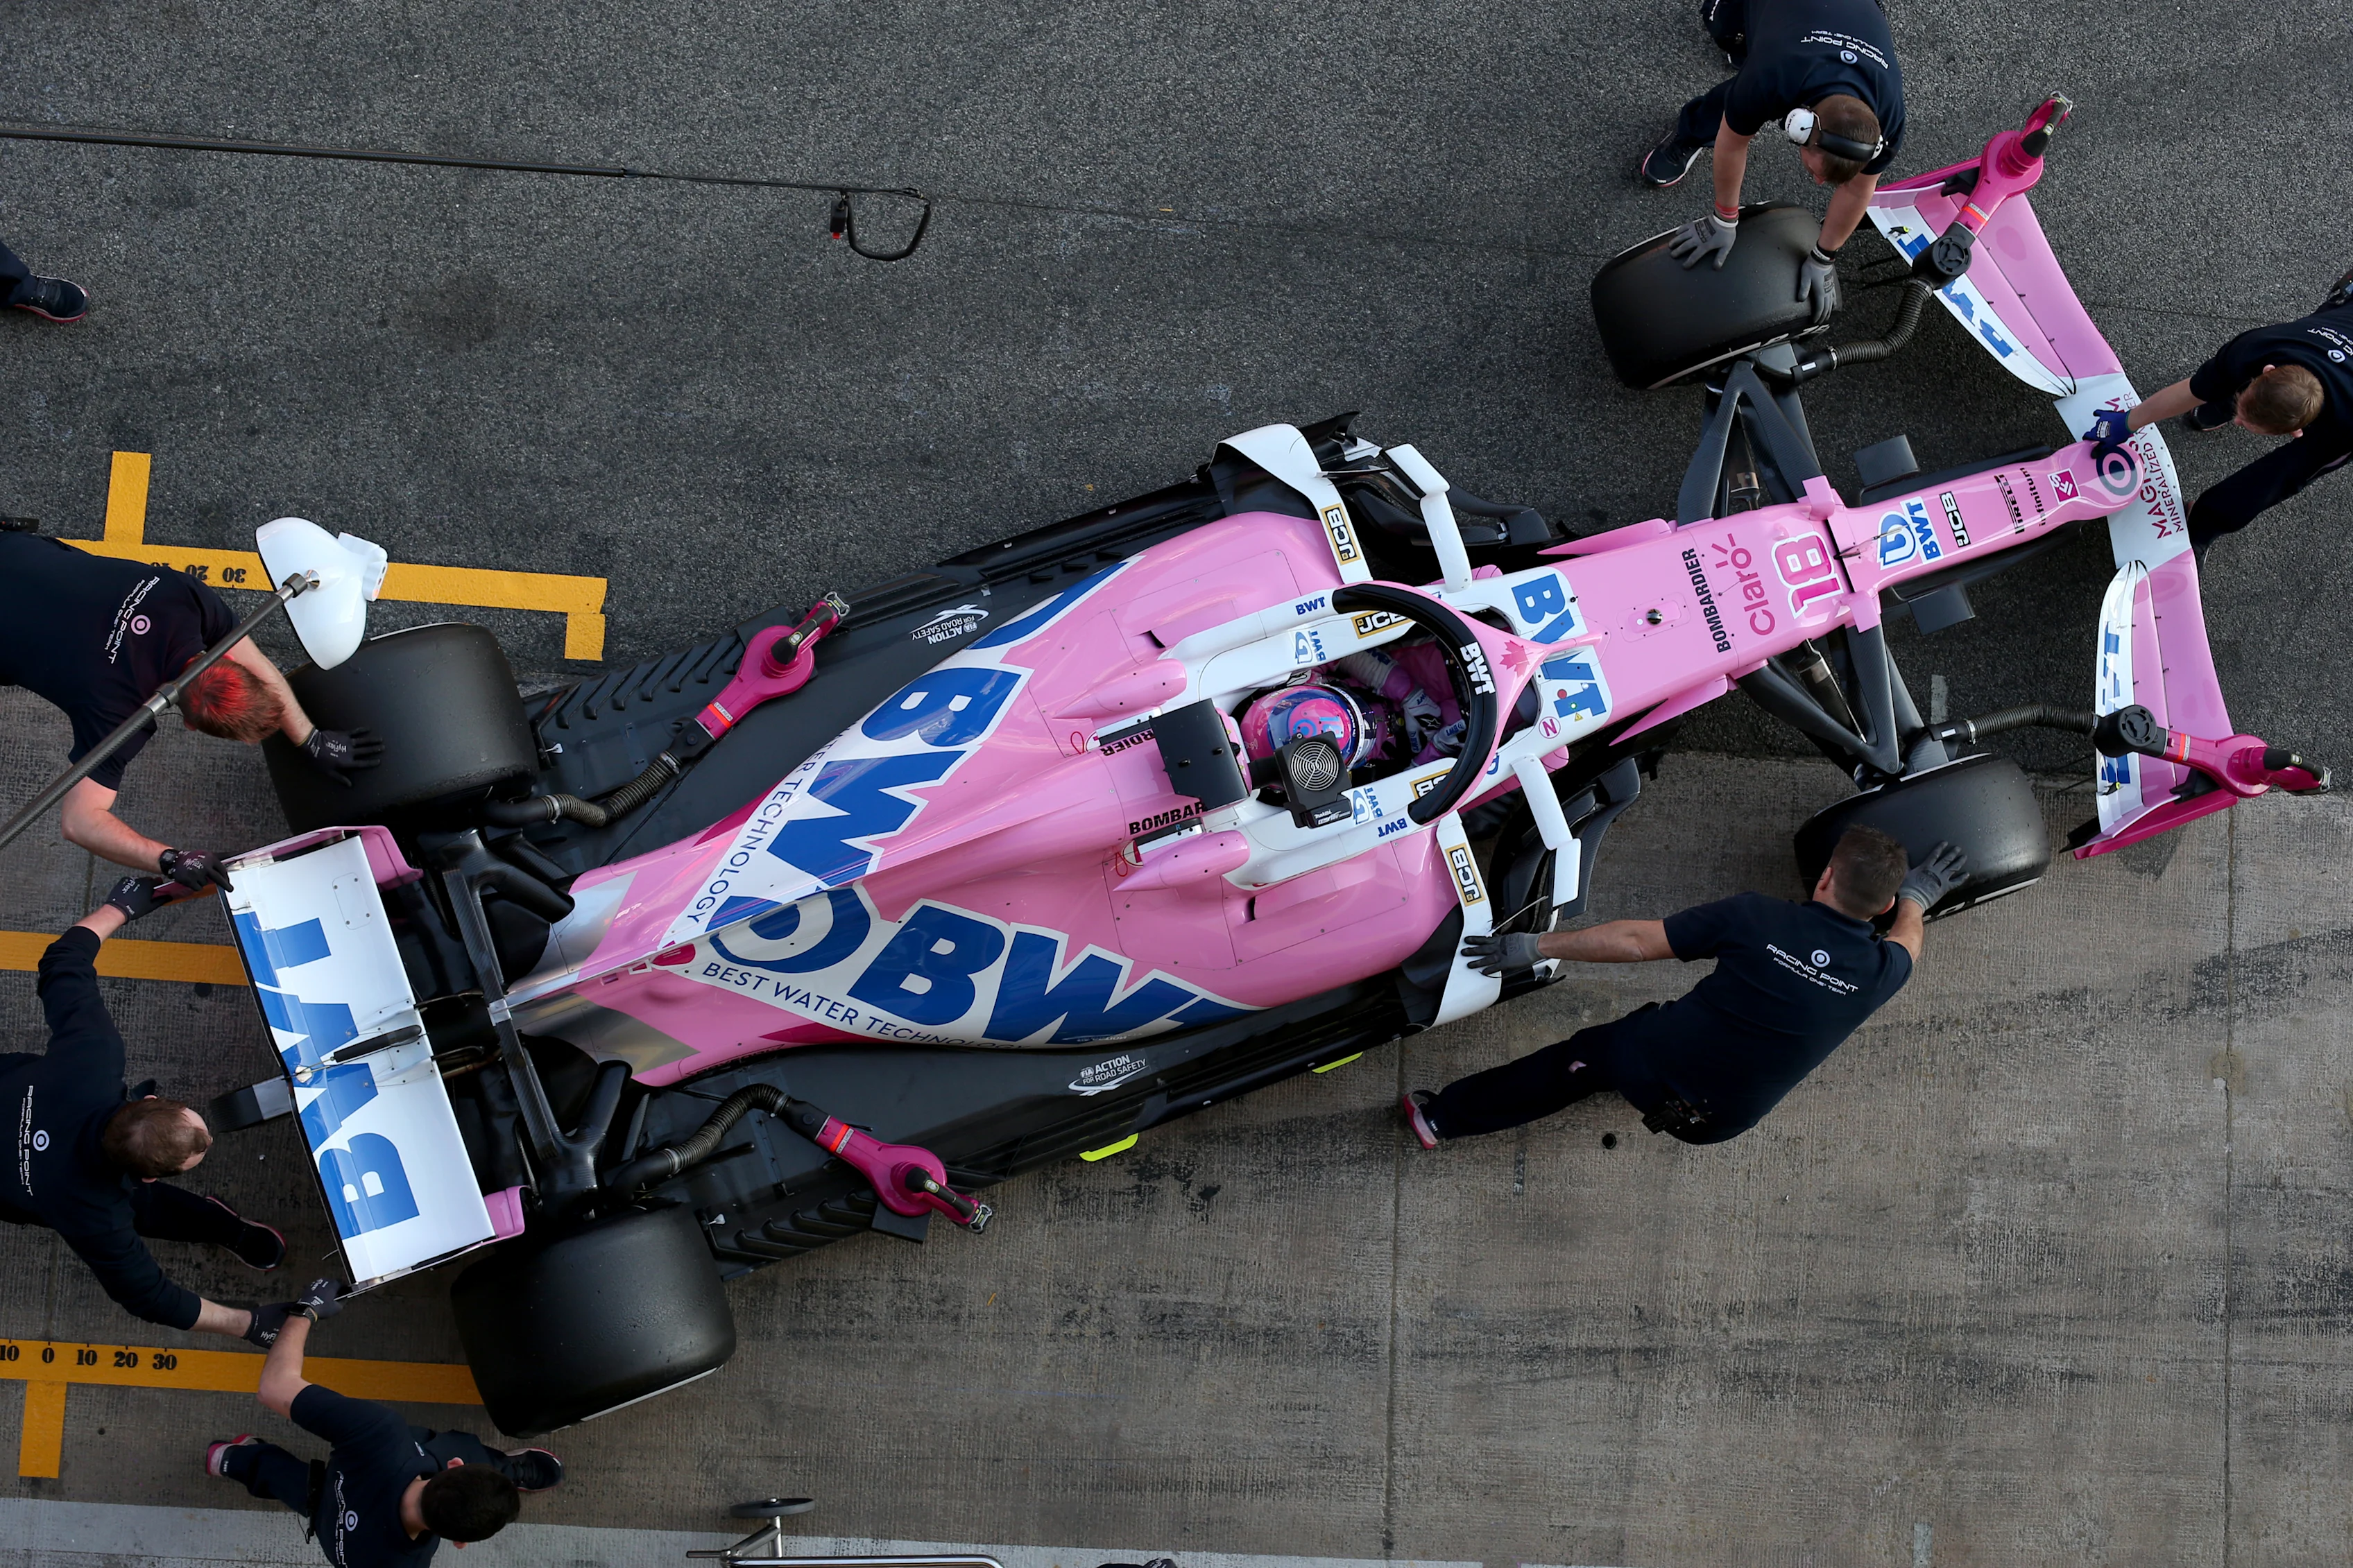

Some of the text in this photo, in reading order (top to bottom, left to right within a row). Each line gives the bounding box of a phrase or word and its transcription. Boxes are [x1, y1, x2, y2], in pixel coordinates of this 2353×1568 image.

[1800, 36, 1889, 69] RACING POINT
[2307, 328, 2343, 346] POINT
[1994, 474, 2025, 534] PIRELLI
[2020, 467, 2046, 526] infinitum
[2143, 442, 2184, 533] MINERALIZED
[1326, 508, 1355, 560] JCB
[1907, 502, 1942, 560] BWT
[1940, 492, 1970, 547] JCB
[123, 576, 161, 620] RACING
[222, 567, 246, 583] 30
[1730, 548, 1776, 636] Claro
[1771, 531, 1845, 619] 18
[1295, 596, 1326, 615] BWT
[1682, 547, 1732, 653] BOMBARDIER
[108, 619, 128, 664] POINT
[912, 614, 975, 641] FOR ROAD SAFETY
[927, 622, 977, 645] FIA ACTION
[1308, 630, 1326, 662] BWT
[1511, 573, 1607, 718] BWT
[1460, 641, 1496, 696] BWT
[1541, 718, 1557, 736] N
[1129, 802, 1208, 836] BOMBAR
[1364, 787, 1384, 818] BWT
[687, 778, 803, 922] TECHNOLOGY
[1378, 818, 1407, 838] BWT
[1451, 848, 1480, 901] JCB
[1766, 943, 1858, 992] RACING POINT
[1773, 957, 1808, 979] FORMULA
[1828, 985, 1846, 996] TEAM
[702, 962, 769, 992] BEST
[773, 981, 859, 1026] WATER
[231, 911, 420, 1241] BWT
[1081, 1054, 1130, 1078] FIA ACTION
[1082, 1058, 1146, 1085] FOR ROAD SAFETY
[24, 1085, 34, 1196] RACING POINT
[42, 1347, 55, 1363] 0
[76, 1350, 97, 1365] 10
[114, 1351, 138, 1368] 20
[153, 1354, 177, 1370] 30
